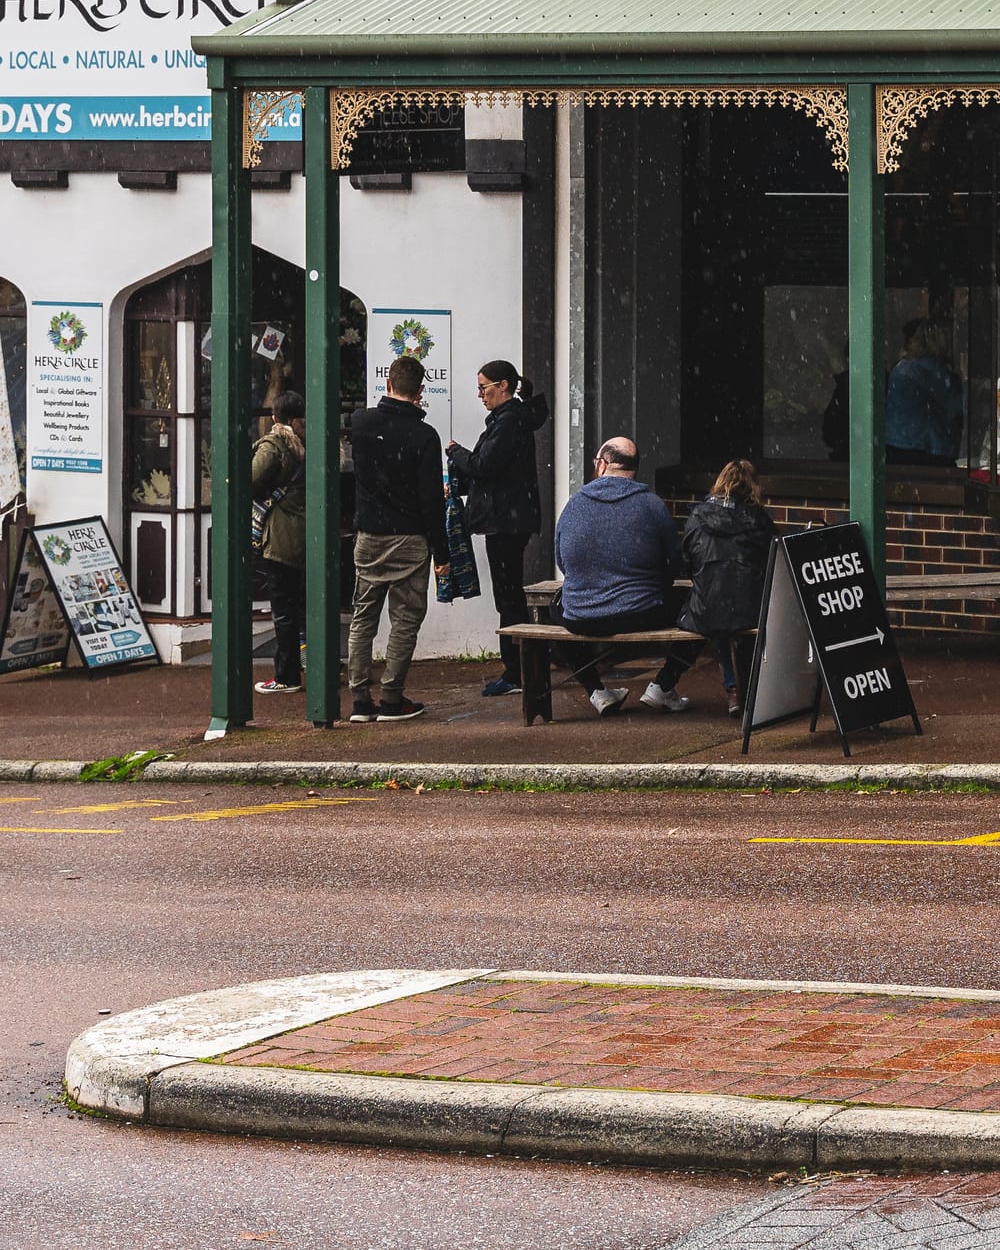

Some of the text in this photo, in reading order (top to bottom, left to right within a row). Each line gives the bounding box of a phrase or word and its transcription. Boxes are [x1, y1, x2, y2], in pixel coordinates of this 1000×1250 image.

[9, 50, 57, 69] LOCAL
[76, 50, 145, 69] NATURAL
[0, 102, 73, 134] DAYS
[35, 356, 99, 371] HERB CIRCLE
[40, 374, 81, 382] SPECIALISING
[58, 387, 74, 395] Global
[76, 388, 97, 396] Giftware
[43, 399, 73, 407] Inspirational
[69, 423, 90, 431] Products
[67, 527, 96, 540] HERB
[73, 537, 107, 553] CIRCLE
[801, 551, 865, 585] CHEESE
[817, 585, 864, 616] SHOP
[95, 652, 118, 664] OPEN
[124, 647, 145, 658] DAYS
[843, 667, 892, 700] OPEN
